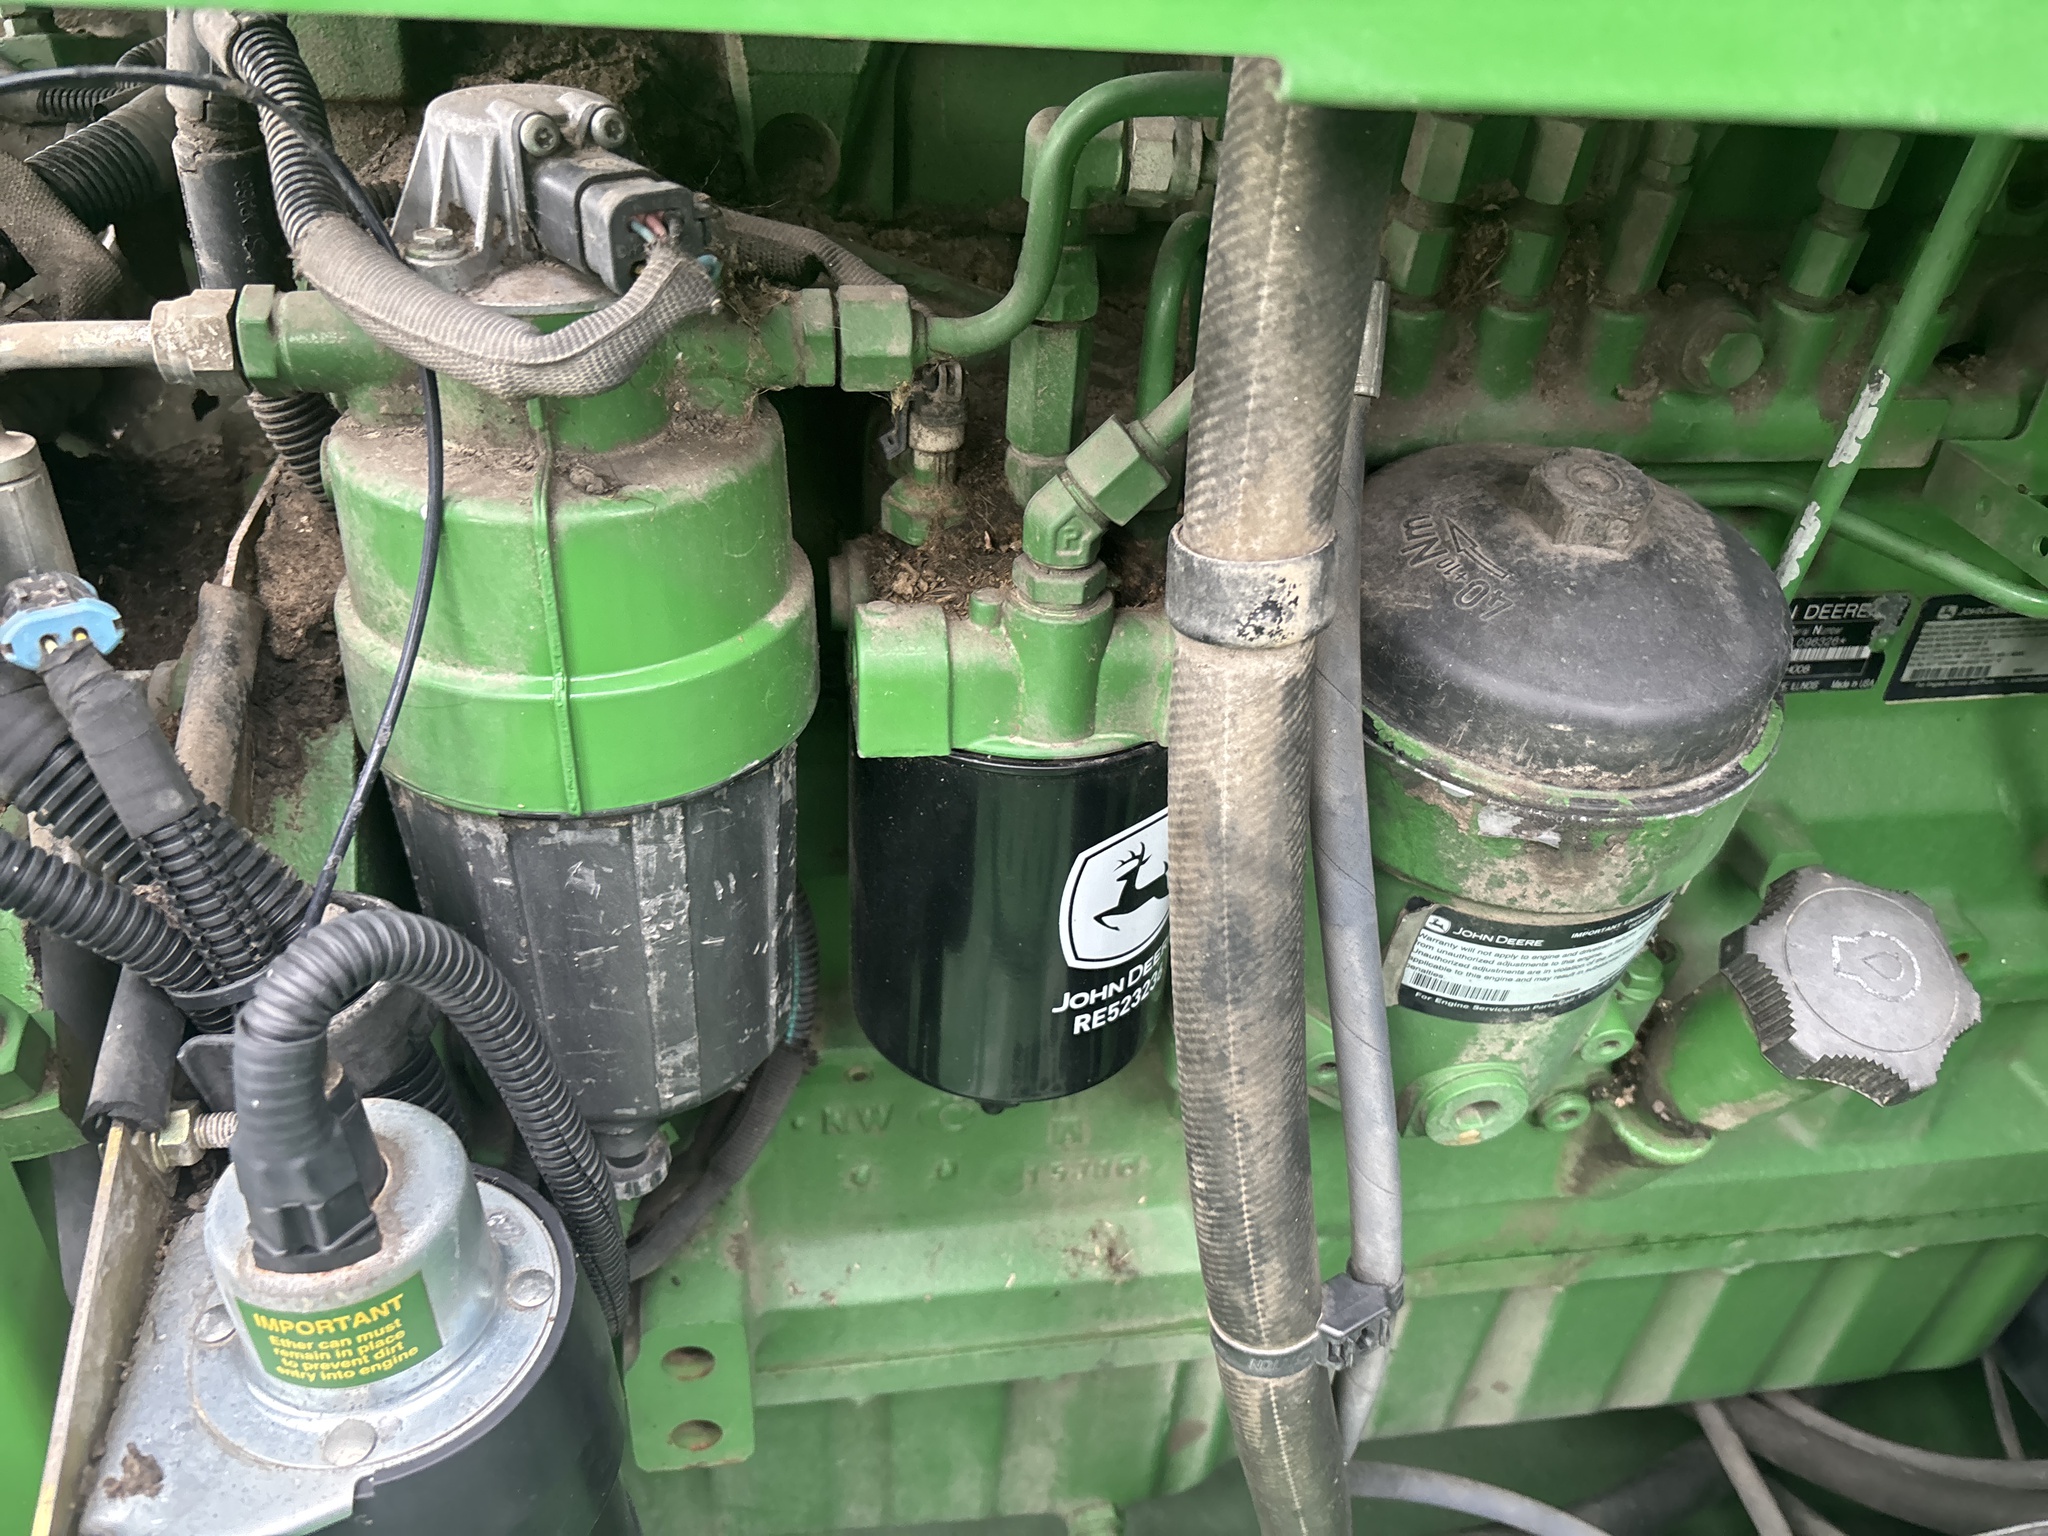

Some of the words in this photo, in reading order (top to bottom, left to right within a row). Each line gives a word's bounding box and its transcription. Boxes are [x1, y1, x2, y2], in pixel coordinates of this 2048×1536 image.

[1803, 603, 1873, 620] DEERE
[1452, 927, 1494, 943] JOHN
[1495, 935, 1545, 947] DEERE
[1571, 922, 1622, 939] IMPORTANT
[1436, 948, 1495, 965] unauthorized
[1496, 960, 1549, 968] adjustments
[1460, 945, 1476, 954] will
[1477, 948, 1492, 957] not
[1494, 952, 1519, 961] apply
[1531, 953, 1560, 961] engine
[1562, 951, 1578, 959] and
[1472, 965, 1525, 975] adjustments
[1051, 977, 1125, 1014] JOHN
[1415, 991, 1433, 1001] For
[1434, 997, 1470, 1009] Engine
[1532, 1003, 1556, 1011] Parts
[253, 1293, 404, 1336] IMPORTANT
[268, 1335, 314, 1350] Ether
[318, 1337, 352, 1350] can
[355, 1318, 402, 1343] must
[273, 1347, 331, 1360] remain
[335, 1347, 353, 1359] in
[356, 1330, 406, 1356] place
[276, 1366, 317, 1382] entry
[320, 1369, 355, 1381] into
[359, 1346, 419, 1375] engine
[281, 1357, 298, 1368] to
[301, 1354, 370, 1371] prevent
[373, 1341, 404, 1360] dirt
